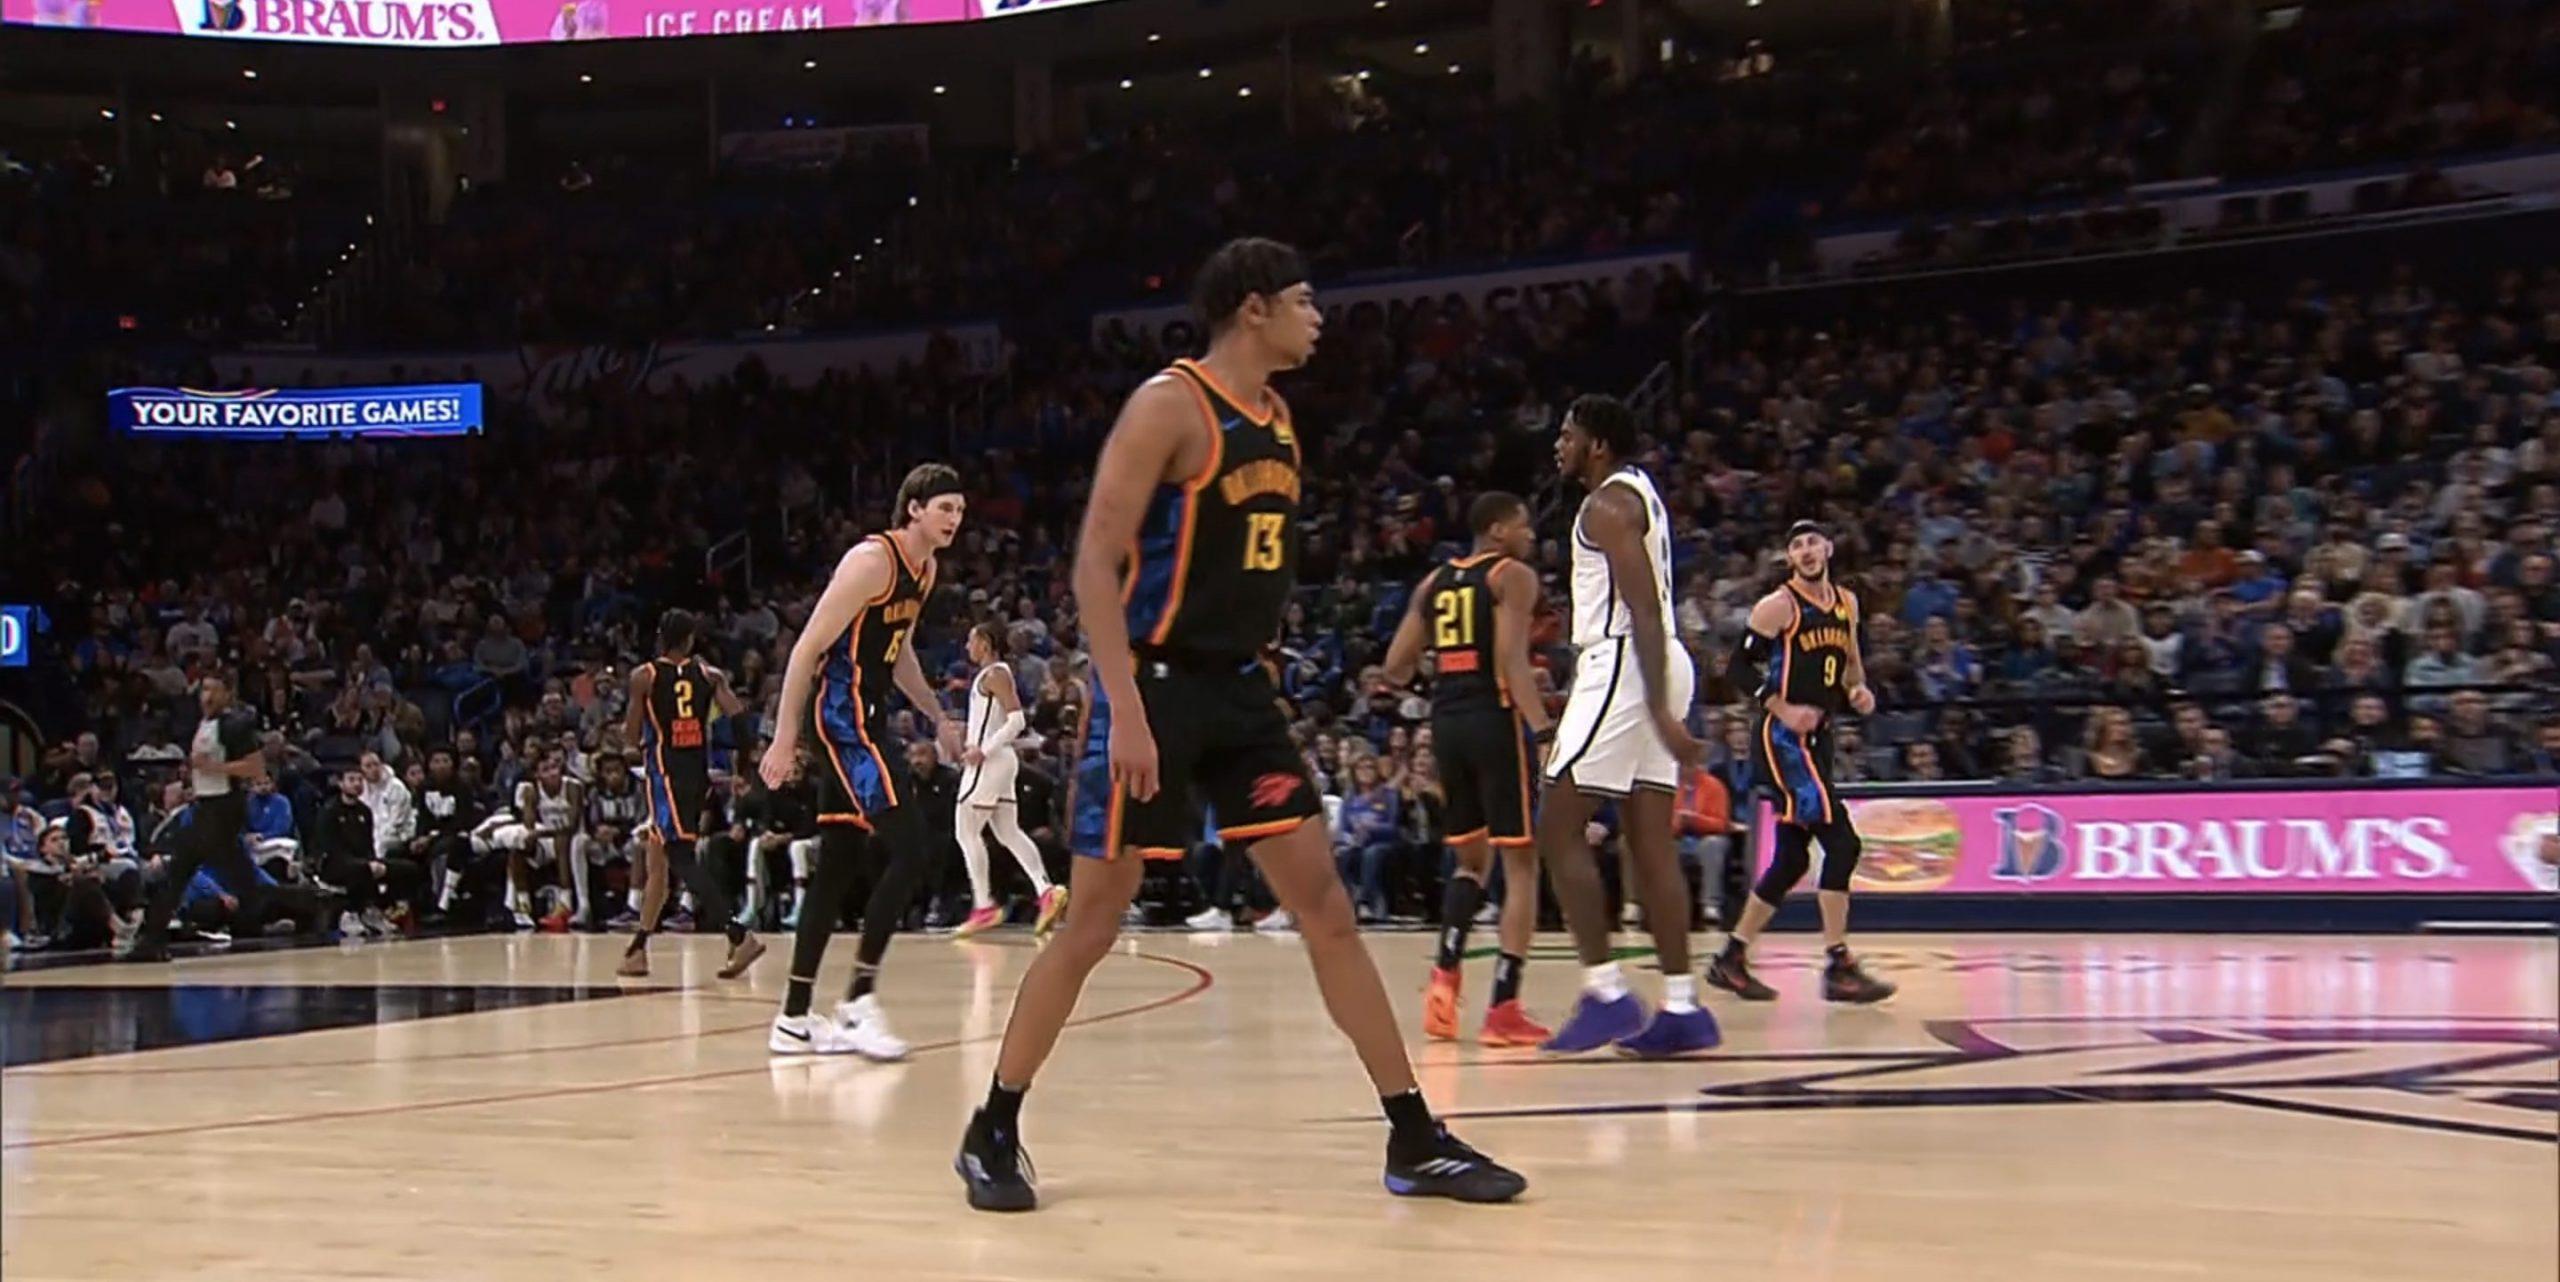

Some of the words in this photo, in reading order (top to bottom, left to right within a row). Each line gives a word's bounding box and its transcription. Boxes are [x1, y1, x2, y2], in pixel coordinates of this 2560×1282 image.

[645, 11, 697, 38] ICE
[713, 4, 824, 35] CREAM
[131, 402, 218, 425] YOUR
[225, 402, 357, 426] FAVORITE
[362, 399, 460, 422] GAMES!
[1243, 513, 1285, 570] 13
[1434, 587, 1475, 648] 21
[1824, 655, 1837, 687] 9
[673, 680, 693, 718] 2
